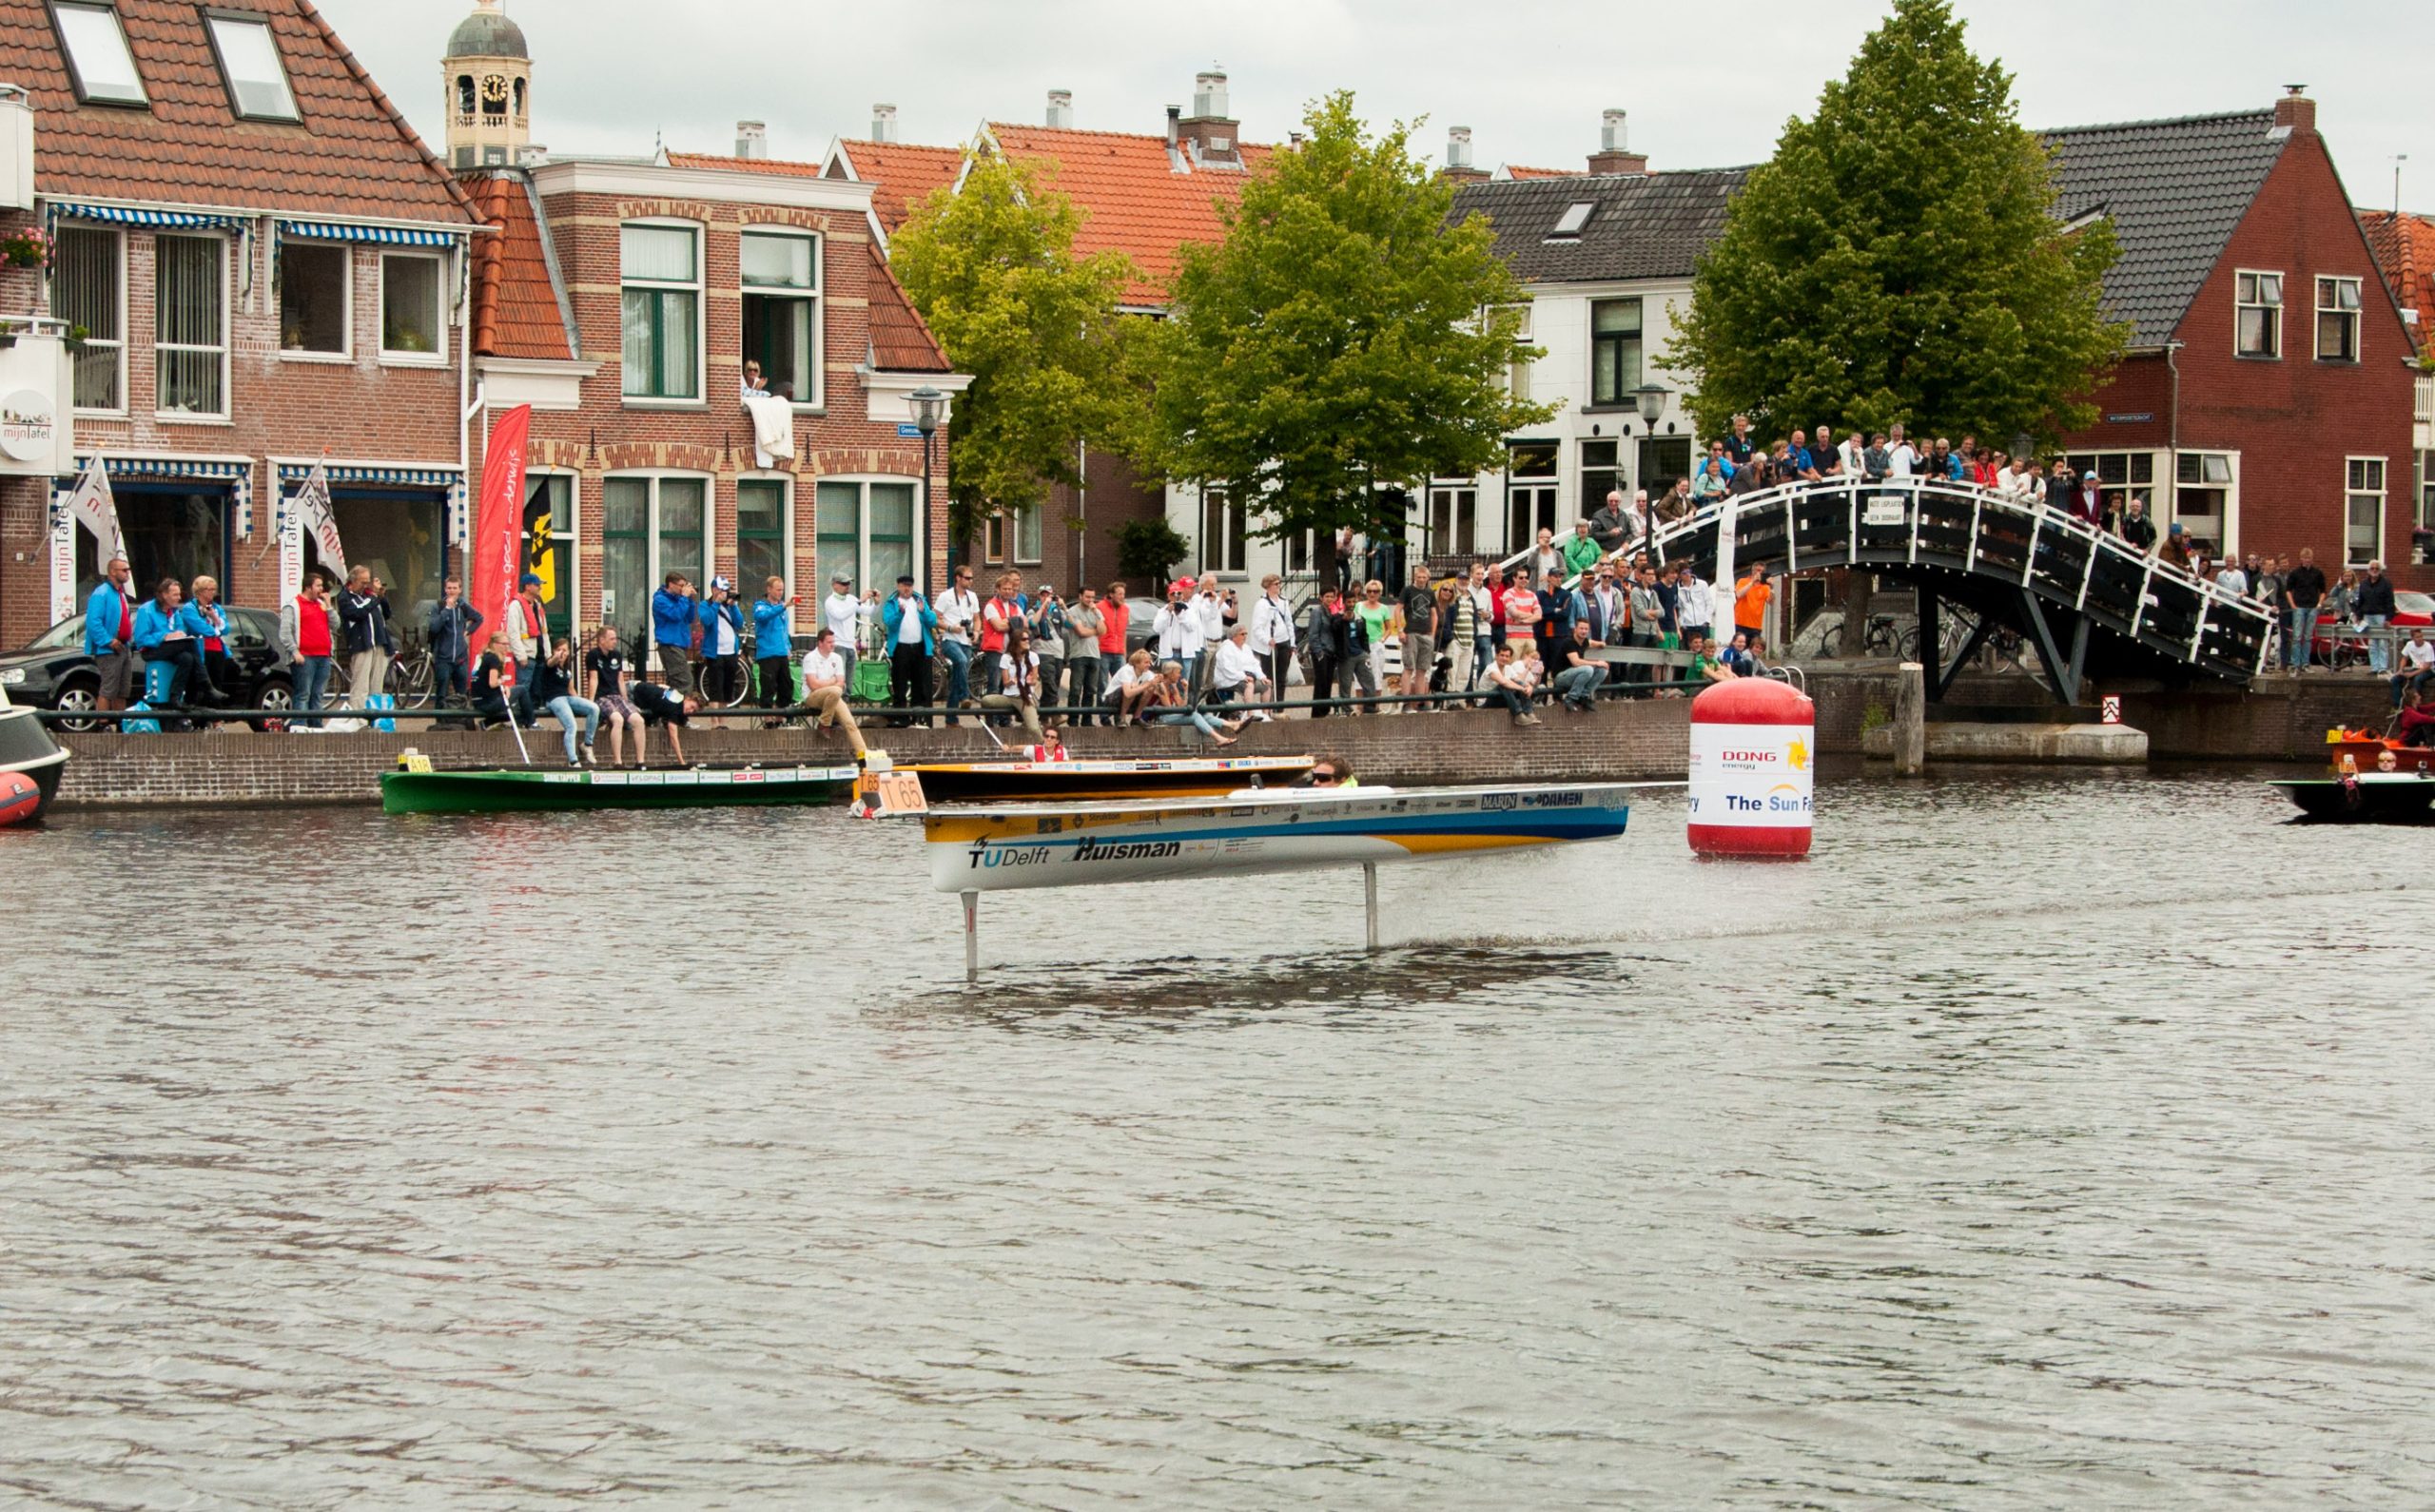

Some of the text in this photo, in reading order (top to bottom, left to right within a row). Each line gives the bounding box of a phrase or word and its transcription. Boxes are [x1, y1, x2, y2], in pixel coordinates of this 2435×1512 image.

[503, 531, 515, 573] goed
[1723, 751, 1777, 762] DONG
[867, 774, 879, 791] 65
[881, 780, 922, 808] T 65
[1482, 794, 1517, 809] MARIN
[1541, 792, 1584, 806] DAMEN
[1726, 795, 1813, 811] The Sun Fa
[1072, 837, 1181, 862] Huisman
